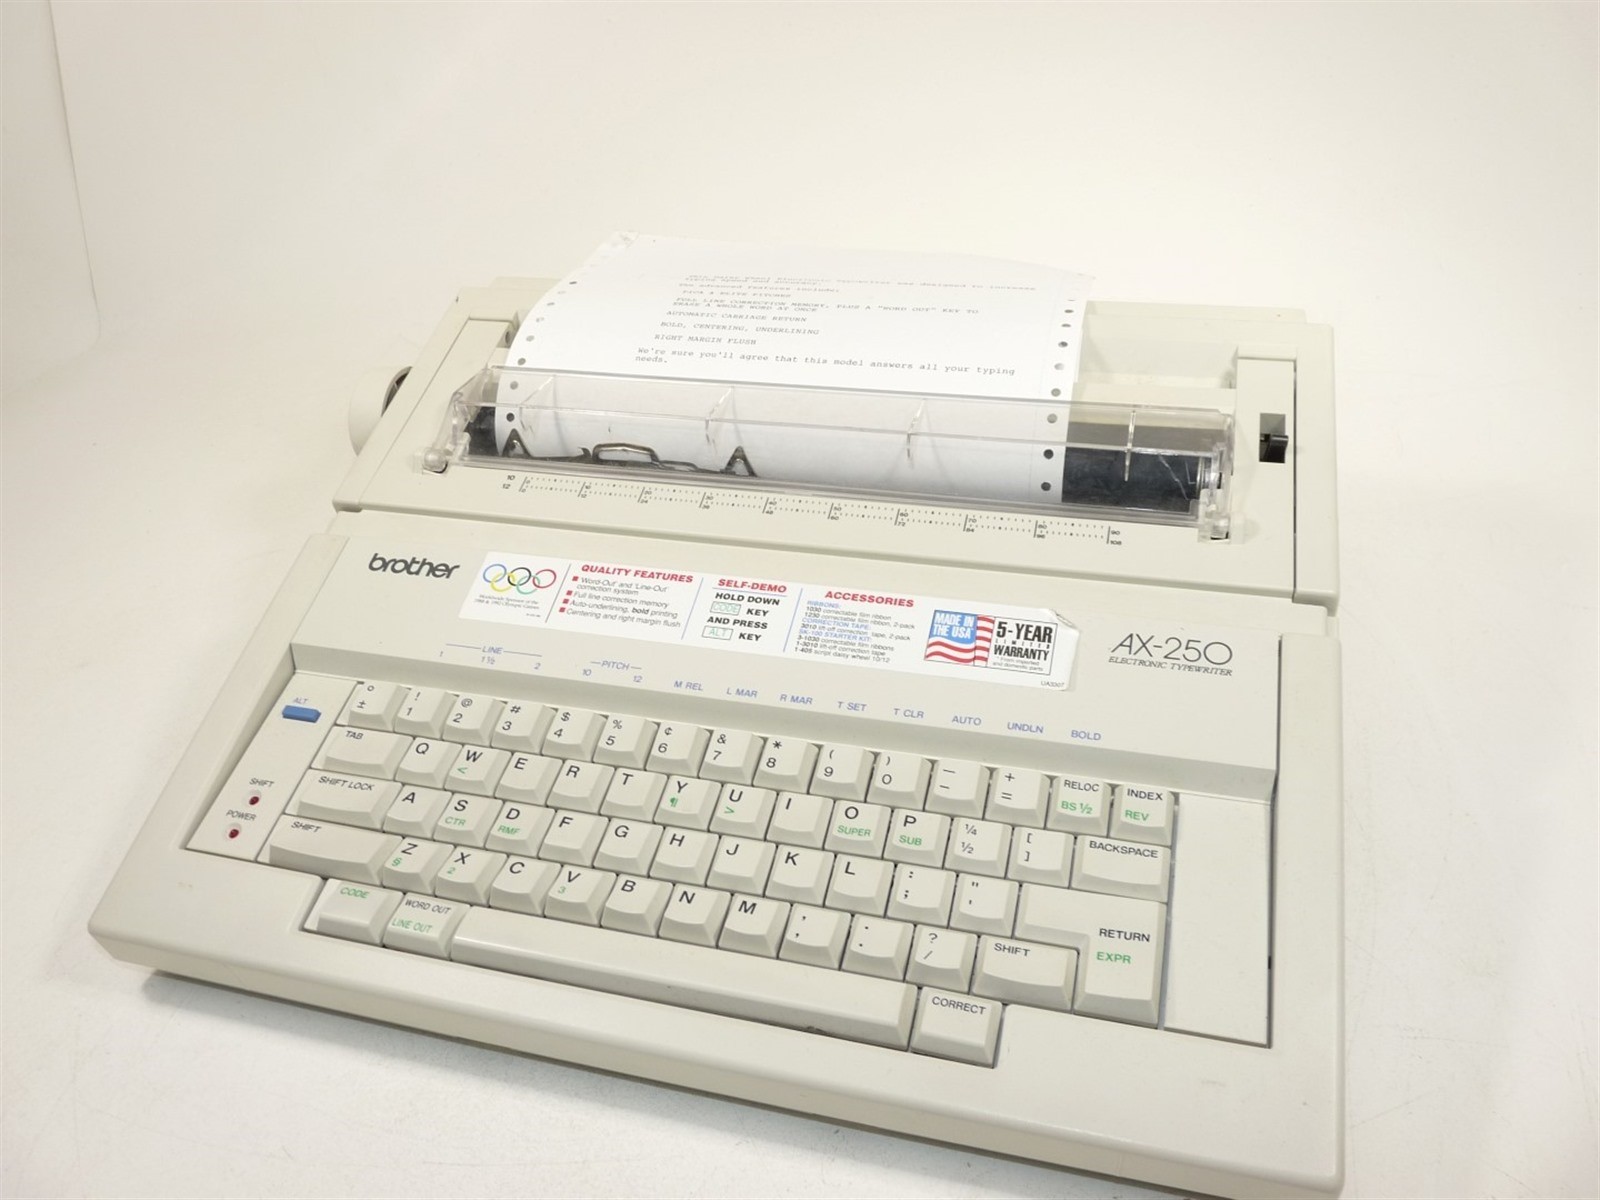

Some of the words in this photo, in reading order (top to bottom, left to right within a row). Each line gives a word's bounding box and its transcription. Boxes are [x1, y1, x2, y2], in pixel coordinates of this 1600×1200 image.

[755, 326, 820, 335] UNDERLINING
[687, 336, 722, 344] MARGIN
[634, 355, 668, 364] needs.
[637, 347, 666, 356] We're
[699, 351, 734, 360] you'll
[739, 354, 769, 363] agree
[774, 355, 798, 363] that
[804, 357, 828, 365] this
[833, 359, 864, 367] model
[870, 361, 913, 370] answers
[919, 363, 937, 371] all
[944, 365, 970, 373] your
[976, 366, 1015, 376] typing
[368, 552, 460, 579] brother
[581, 564, 632, 577] QUALITY
[633, 569, 693, 583] FEATURES
[576, 584, 611, 594] correction
[613, 588, 639, 597] system
[618, 580, 632, 589] and
[718, 578, 787, 592] SELF-DEMO
[573, 590, 587, 599] Full
[588, 592, 602, 601] line
[603, 594, 638, 605] correction
[640, 599, 670, 610] memory
[714, 592, 745, 602] HOLD
[747, 595, 780, 606] DOWN
[824, 591, 914, 607] ACCESSORIES
[570, 599, 629, 614] Auto-underlining,
[631, 606, 650, 616] bold
[650, 608, 679, 620] printing
[746, 607, 770, 618] KEY
[566, 607, 601, 621] Centering
[602, 611, 617, 621] and
[617, 613, 635, 624] right
[636, 616, 662, 627] margin
[663, 618, 681, 629] flush
[706, 616, 731, 626] AND
[732, 619, 768, 631] PRESS
[933, 612, 961, 627] MADE
[963, 616, 975, 628] IN
[708, 628, 728, 637] ALT
[738, 632, 762, 643] KEY
[932, 624, 949, 637] THE
[996, 621, 1053, 644] 5-YEAR
[482, 645, 503, 655] LINE
[994, 644, 1050, 661] WARRANTY
[1111, 633, 1233, 665] AX-250
[601, 660, 630, 671] PITCH
[1108, 656, 1167, 669] ELECTRONIC
[1170, 662, 1233, 676] TYPEWRITER
[582, 668, 592, 677] 10
[633, 675, 643, 683] 12
[673, 680, 683, 688] M
[685, 681, 704, 691] REL
[726, 687, 732, 695] L
[735, 688, 758, 698] MAR
[780, 693, 788, 702] R
[790, 695, 813, 705] MAR
[405, 707, 413, 716] 1
[837, 701, 844, 709] T
[847, 702, 867, 712] SET
[452, 713, 463, 723] 2
[893, 708, 900, 716] T
[903, 709, 924, 719] CLR
[502, 721, 512, 731] 3
[951, 715, 982, 726] AUTO
[1007, 721, 1044, 733] UNDLN
[345, 730, 364, 740] TAB
[553, 728, 563, 738] 4
[1071, 730, 1101, 741] BOLD
[605, 735, 616, 746] 5
[415, 743, 430, 756] Q
[658, 742, 668, 753] 6
[465, 750, 483, 763] W
[713, 751, 723, 761] 7
[766, 757, 777, 768] 8
[514, 758, 528, 770] E
[565, 765, 581, 778] R
[823, 766, 834, 777] 9
[248, 777, 275, 788] SHIFT
[318, 776, 349, 789] SHIFT
[349, 781, 375, 792] LOCK
[621, 773, 634, 786] T
[1063, 779, 1099, 792] RELOC
[675, 781, 688, 794] Y
[401, 791, 417, 804] A
[729, 789, 743, 803] U
[1127, 788, 1163, 801] INDEX
[454, 800, 468, 812] S
[785, 797, 792, 810] I
[1060, 800, 1077, 811] BS
[225, 809, 257, 822] POWER
[505, 808, 521, 821] D
[844, 805, 859, 820] O
[1124, 809, 1149, 822] REV
[290, 821, 322, 833] SHIFT
[444, 816, 466, 827] CTR
[559, 815, 573, 828] F
[903, 814, 917, 828] P
[497, 825, 521, 836] RMF
[614, 824, 630, 838] G
[837, 824, 872, 838] SUPER
[669, 834, 685, 847] H
[898, 834, 922, 846] SUB
[401, 843, 418, 855] Z
[726, 843, 740, 856] J
[1089, 840, 1159, 858] BACKSPACE
[455, 852, 471, 865] X
[784, 852, 799, 866] K
[509, 862, 525, 875] C
[844, 861, 856, 876] L
[567, 870, 581, 884] V
[620, 879, 636, 893] B
[340, 887, 370, 899] CODE
[679, 890, 695, 904] N
[405, 899, 431, 911] WORD
[431, 904, 452, 915] OUT
[738, 900, 757, 915] M
[391, 919, 411, 930] LINE
[413, 923, 433, 934] OUT
[1099, 927, 1151, 943] RETURN
[994, 942, 1030, 957] SHIFT
[1096, 951, 1132, 964] EXPR
[932, 995, 987, 1016] CORRECT
